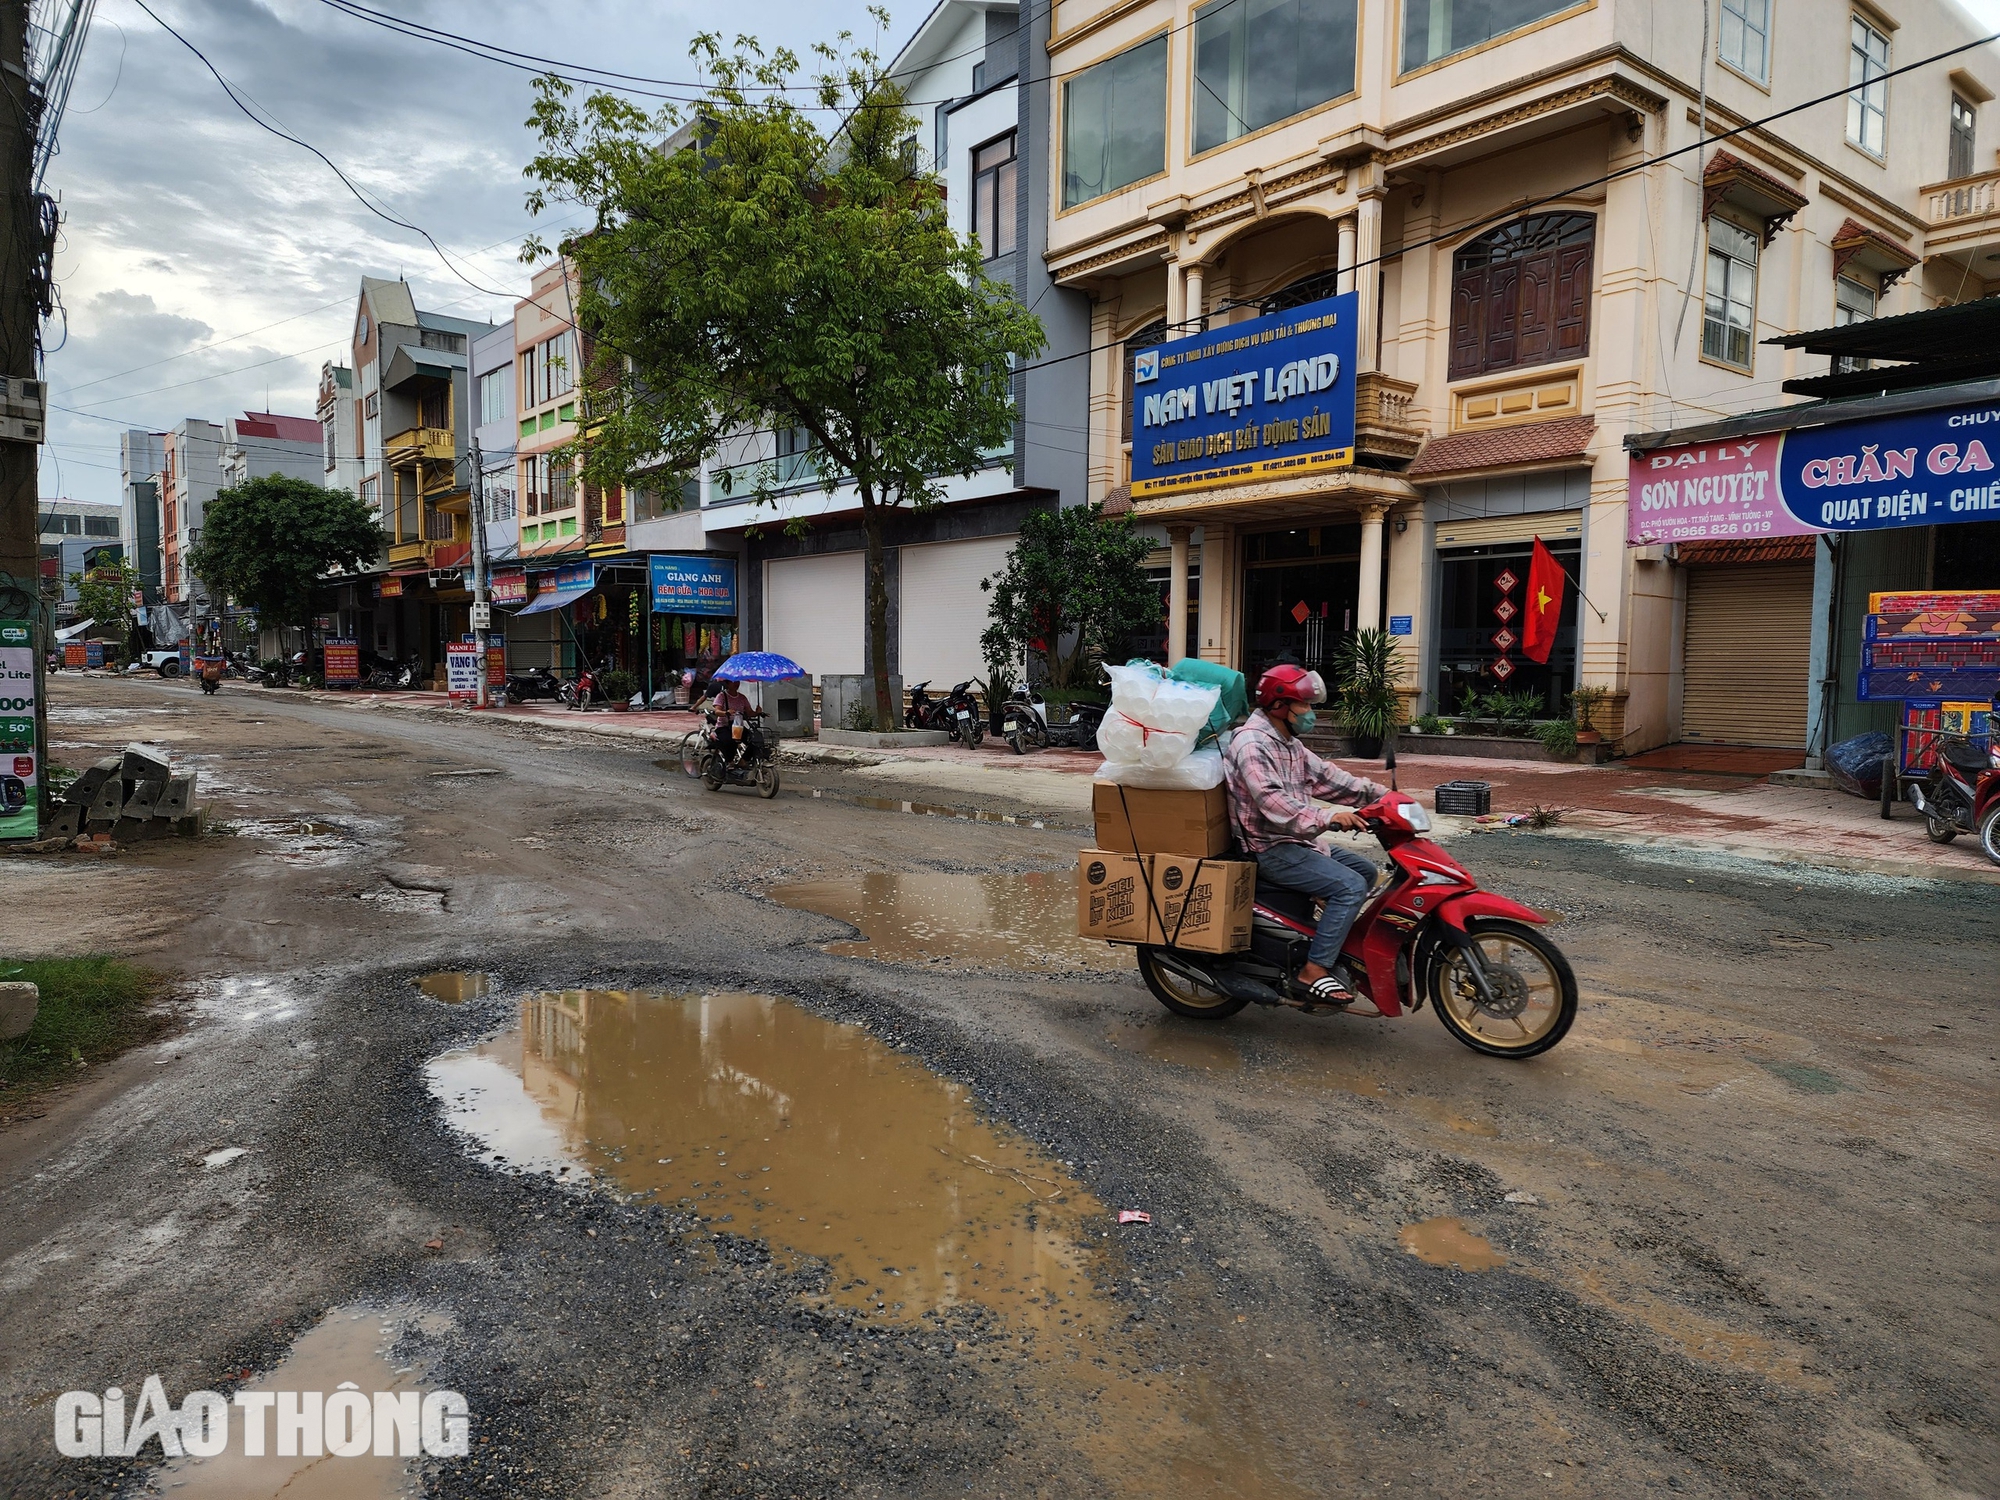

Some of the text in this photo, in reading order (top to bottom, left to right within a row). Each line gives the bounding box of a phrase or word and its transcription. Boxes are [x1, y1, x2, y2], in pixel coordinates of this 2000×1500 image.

[1177, 353, 1185, 364] TY
[1186, 349, 1201, 362] TNHH
[1203, 344, 1215, 358] XÂY
[1216, 340, 1233, 356] DỰNG
[1234, 336, 1250, 351] DỊCH
[1251, 333, 1260, 347] VỤ
[1261, 328, 1275, 344] VẬN
[1275, 322, 1286, 339] TẢI
[1287, 324, 1293, 336] &
[1294, 317, 1321, 335] THƯƠNG
[1322, 313, 1337, 329] MẠI
[1143, 353, 1340, 427] NAM VIỆT LAND
[1153, 406, 1331, 466] SÀN GIAO DỊCH BẤT ĐỘNG SẢN
[1650, 440, 1760, 469] ĐẠI LÝ
[1802, 439, 1995, 489] CHĂN GA
[1641, 462, 1769, 512] SƠN NGUYỆT
[1677, 517, 1688, 525] HOA
[1710, 514, 1725, 522] TANG
[1765, 510, 1773, 518] VP
[1821, 497, 1872, 526] QUẠT
[1877, 489, 1928, 521] ĐIỆN
[1672, 525, 1706, 537] 0966
[1711, 523, 1738, 535] 826
[1742, 521, 1771, 533] 019
[657, 583, 675, 595] RÈM
[677, 583, 692, 596] CỬA
[698, 586, 713, 596] HOA
[667, 572, 721, 583] GIANG ANH
[450, 654, 470, 668] VÀNG
[8, 670, 31, 679] Lite
[1107, 876, 1134, 896] SIÊU
